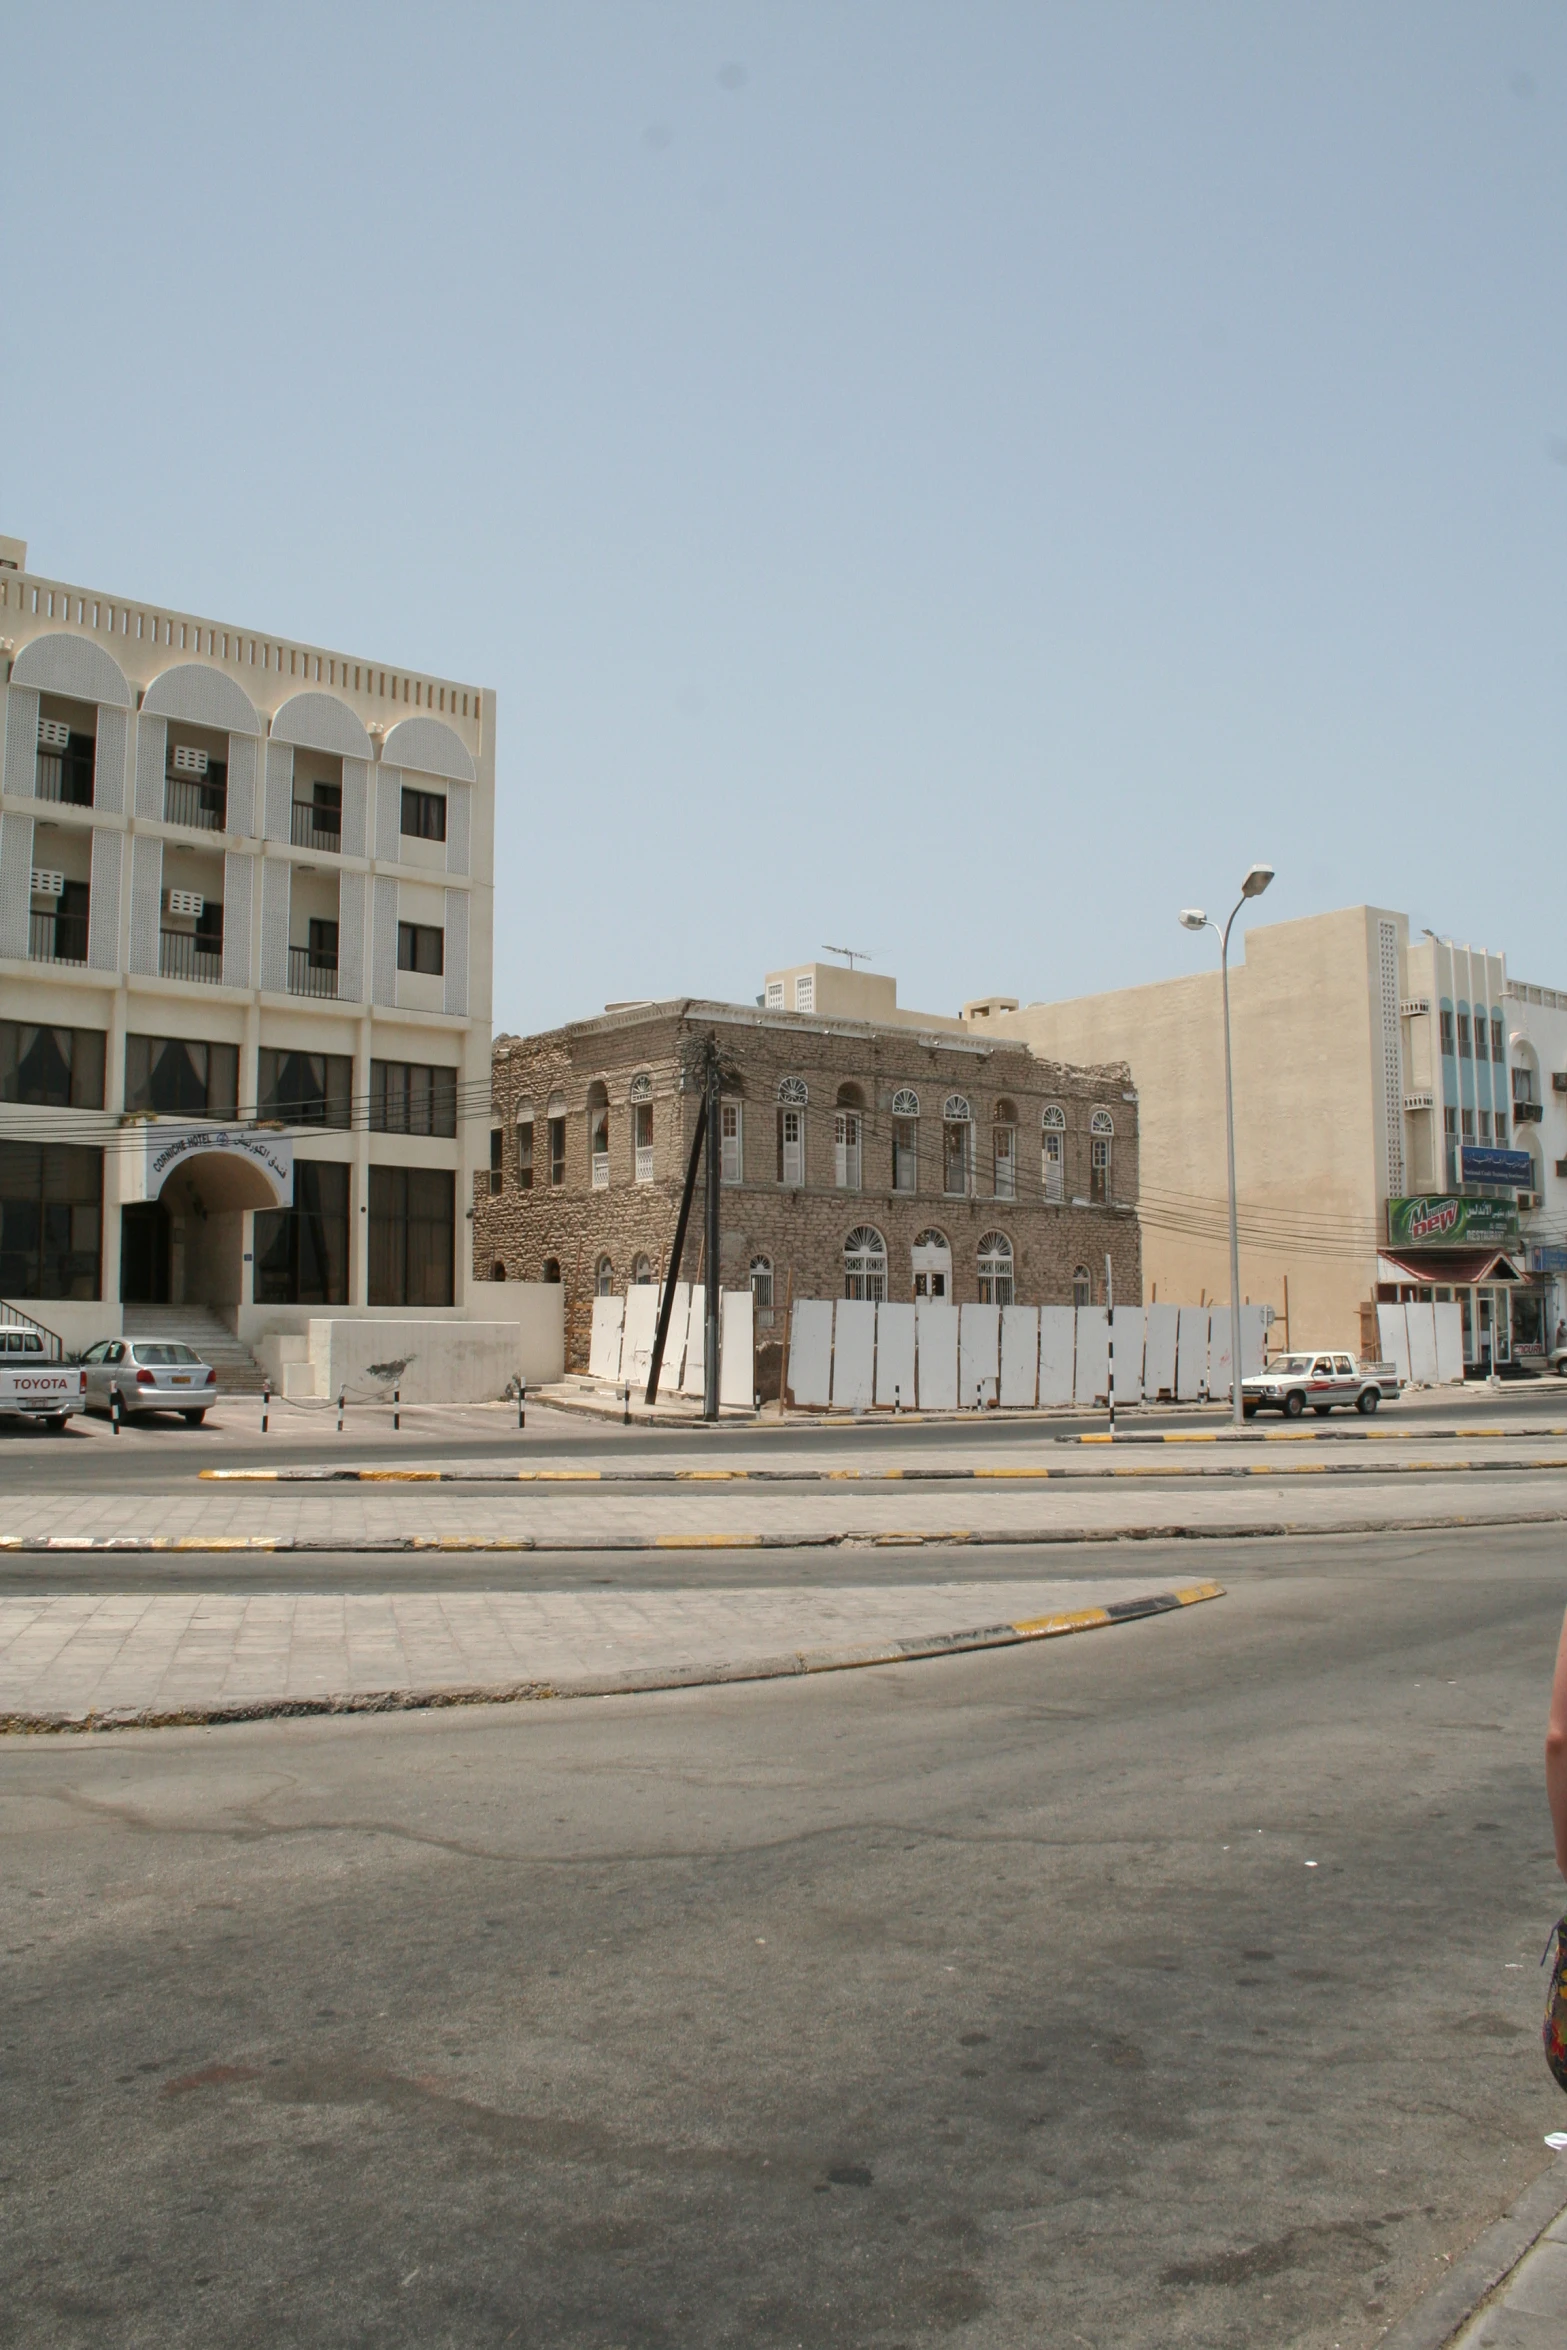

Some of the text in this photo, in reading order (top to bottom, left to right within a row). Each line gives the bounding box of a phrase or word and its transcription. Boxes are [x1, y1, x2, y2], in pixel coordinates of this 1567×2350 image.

[153, 1133, 212, 1173] CORNICHE HOTEL
[268, 1156, 288, 1179] فندق
[13, 1378, 68, 1390] TOYOTA
